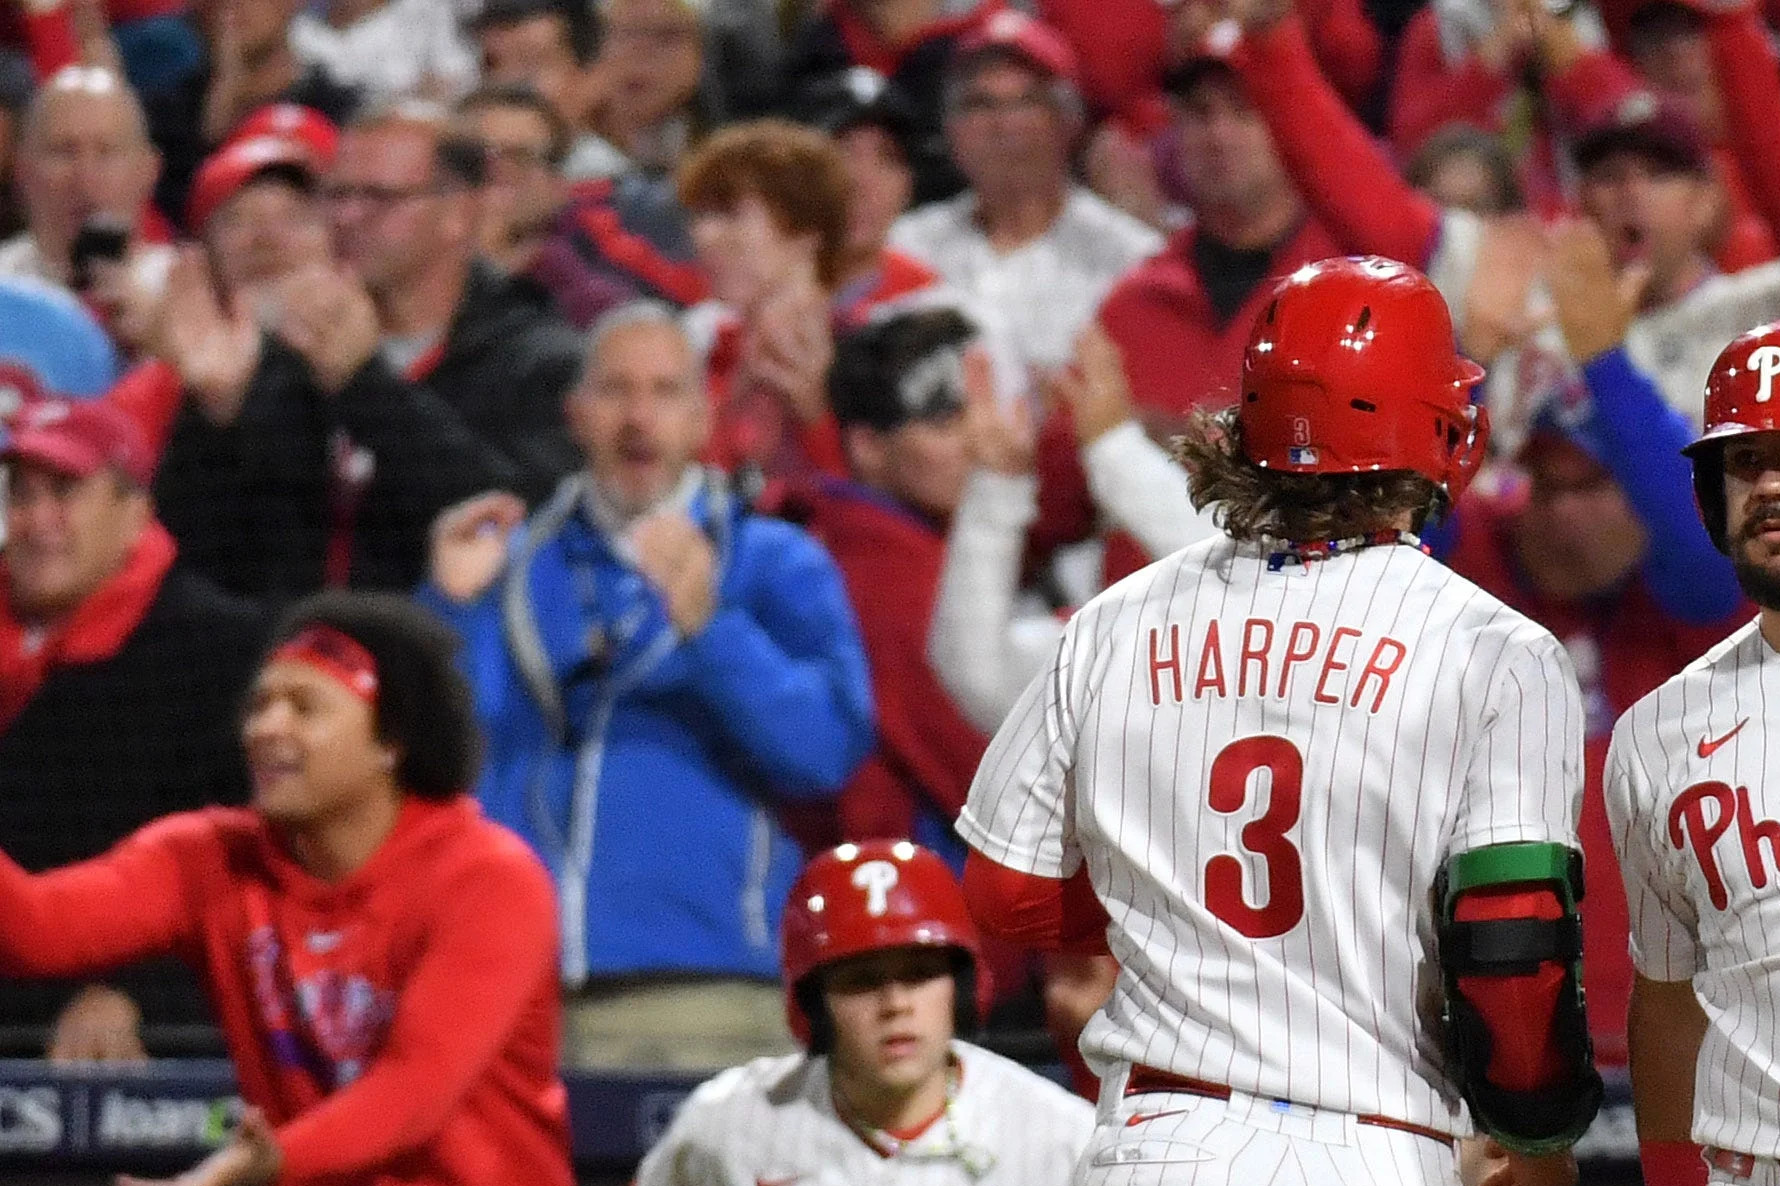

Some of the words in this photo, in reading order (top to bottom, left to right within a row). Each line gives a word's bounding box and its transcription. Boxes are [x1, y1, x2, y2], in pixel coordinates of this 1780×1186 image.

[1293, 417, 1311, 446] 3
[1148, 617, 1407, 714] HARPER
[1204, 734, 1305, 940] 3
[850, 860, 899, 918] P
